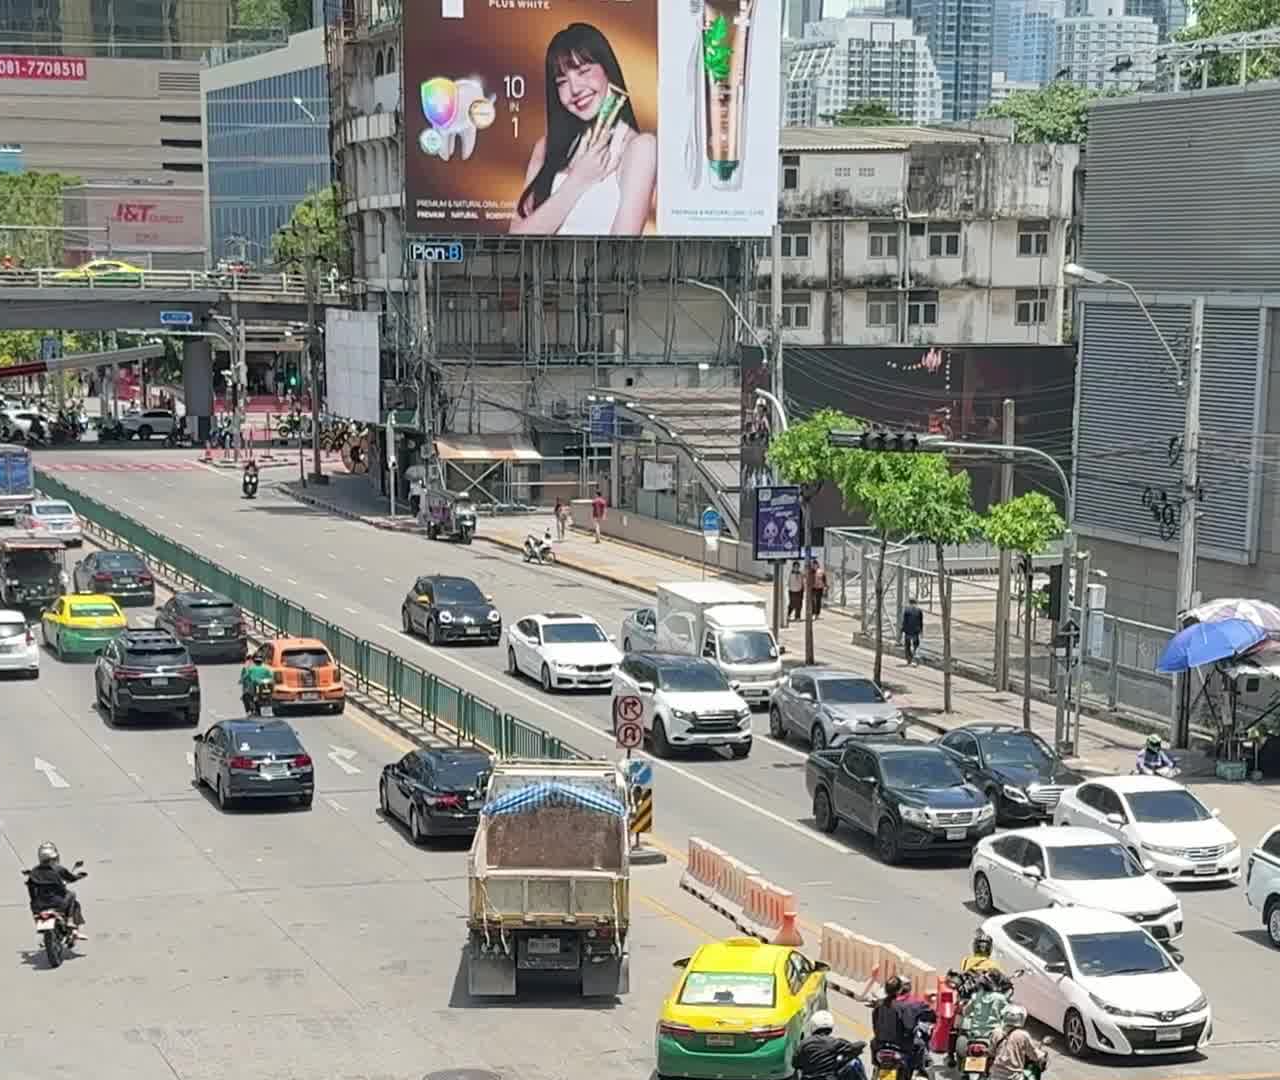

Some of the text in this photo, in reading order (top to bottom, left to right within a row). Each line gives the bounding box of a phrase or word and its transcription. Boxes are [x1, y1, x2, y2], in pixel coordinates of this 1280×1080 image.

[517, 0, 551, 9] WHITE
[504, 75, 526, 99] 10
[508, 103, 520, 113] IN
[510, 117, 520, 139] 1
